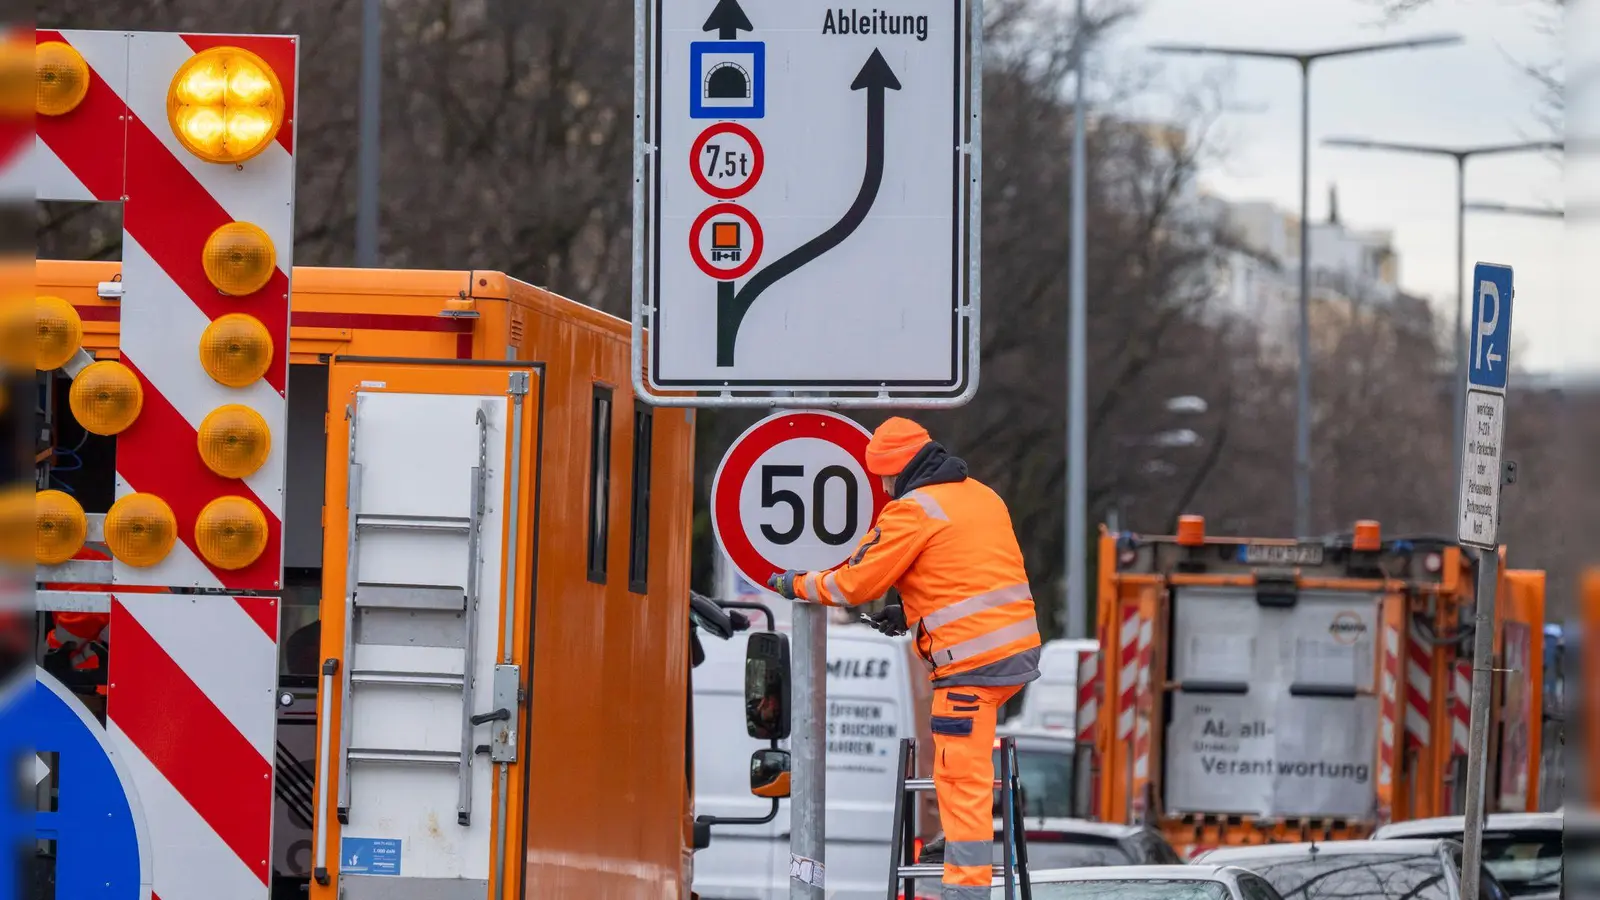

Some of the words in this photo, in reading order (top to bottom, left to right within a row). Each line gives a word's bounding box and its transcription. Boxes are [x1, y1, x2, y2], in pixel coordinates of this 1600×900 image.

[822, 8, 928, 41] Ableitung
[1475, 279, 1500, 370] P
[760, 464, 858, 546] 50
[827, 659, 890, 679] MILES
[1201, 755, 1369, 784] Verantwortung
